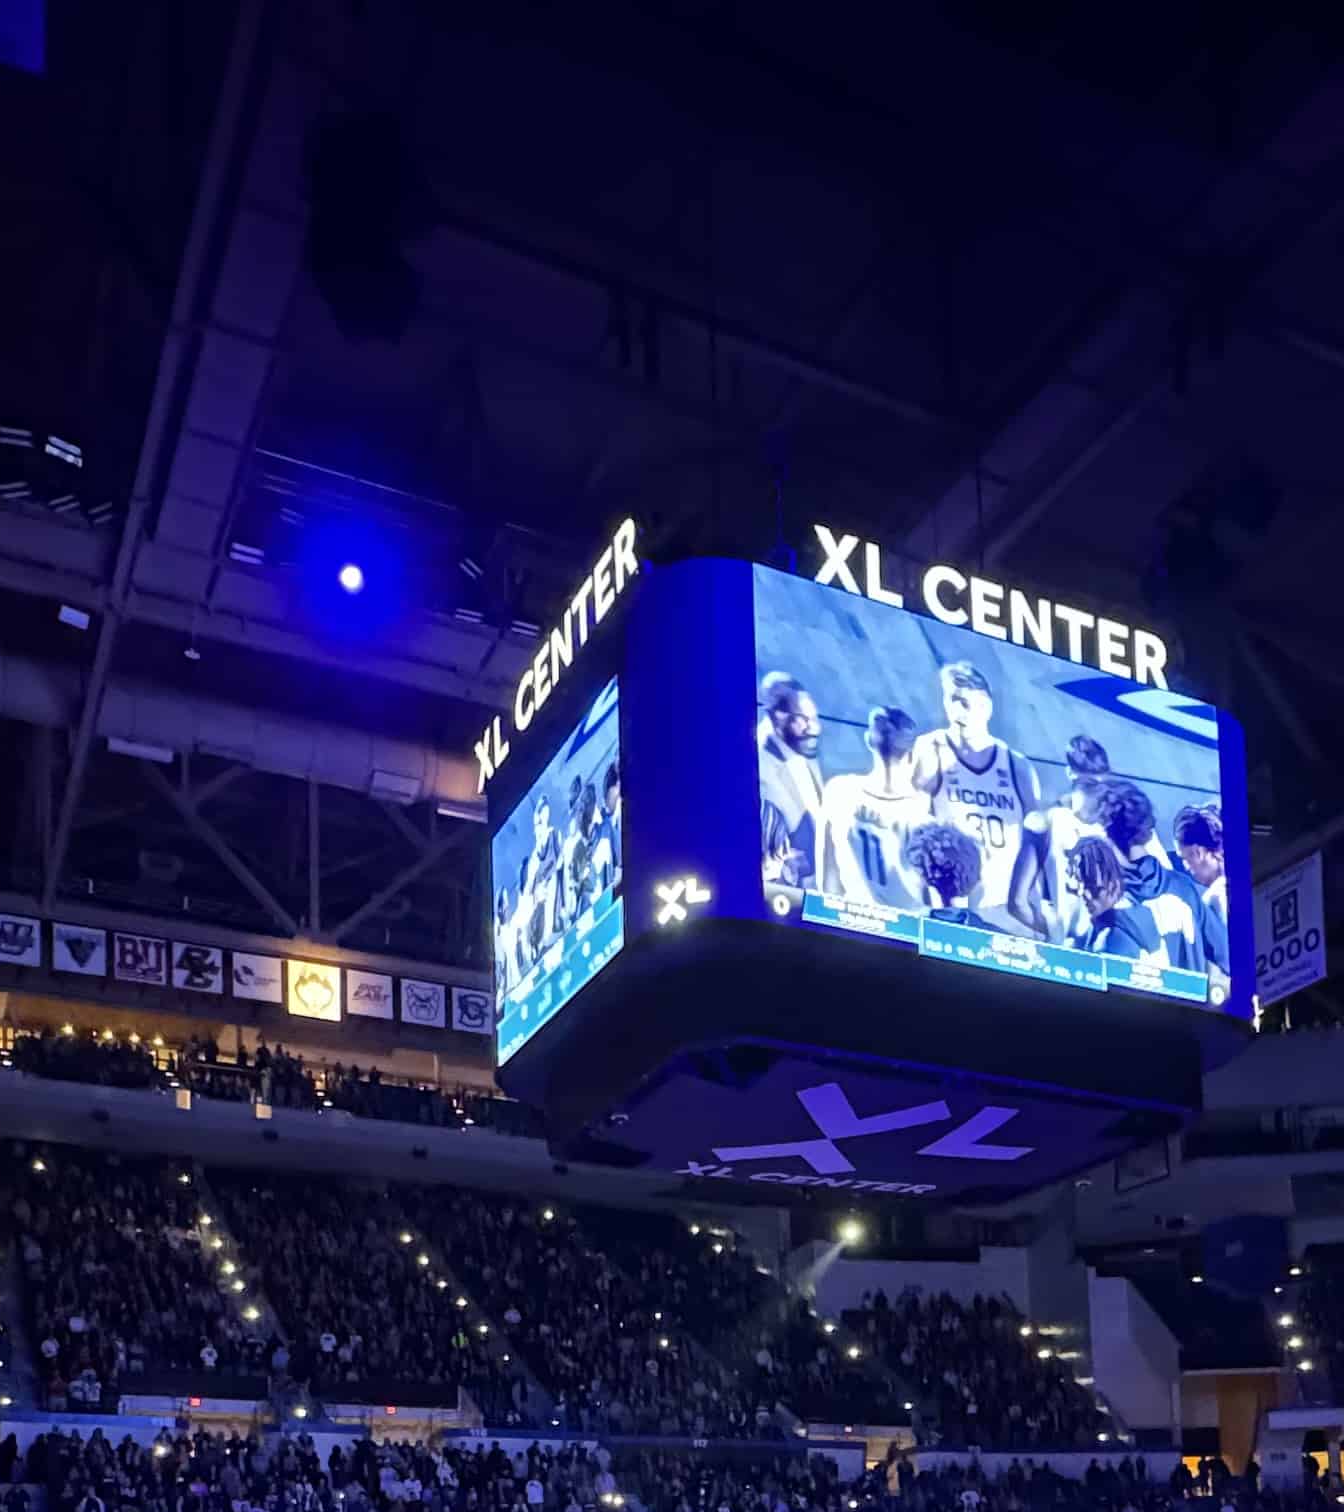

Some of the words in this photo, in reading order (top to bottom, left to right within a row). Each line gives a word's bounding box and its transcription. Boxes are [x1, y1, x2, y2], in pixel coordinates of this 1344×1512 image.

[813, 523, 905, 609] XL
[922, 564, 1170, 691] CENTER
[474, 714, 510, 794] XL
[514, 517, 639, 732] CENTER
[947, 788, 1015, 811] UCONN
[1256, 928, 1320, 977] 2000
[672, 1161, 734, 1178] XL
[749, 1172, 938, 1195] CENTER
